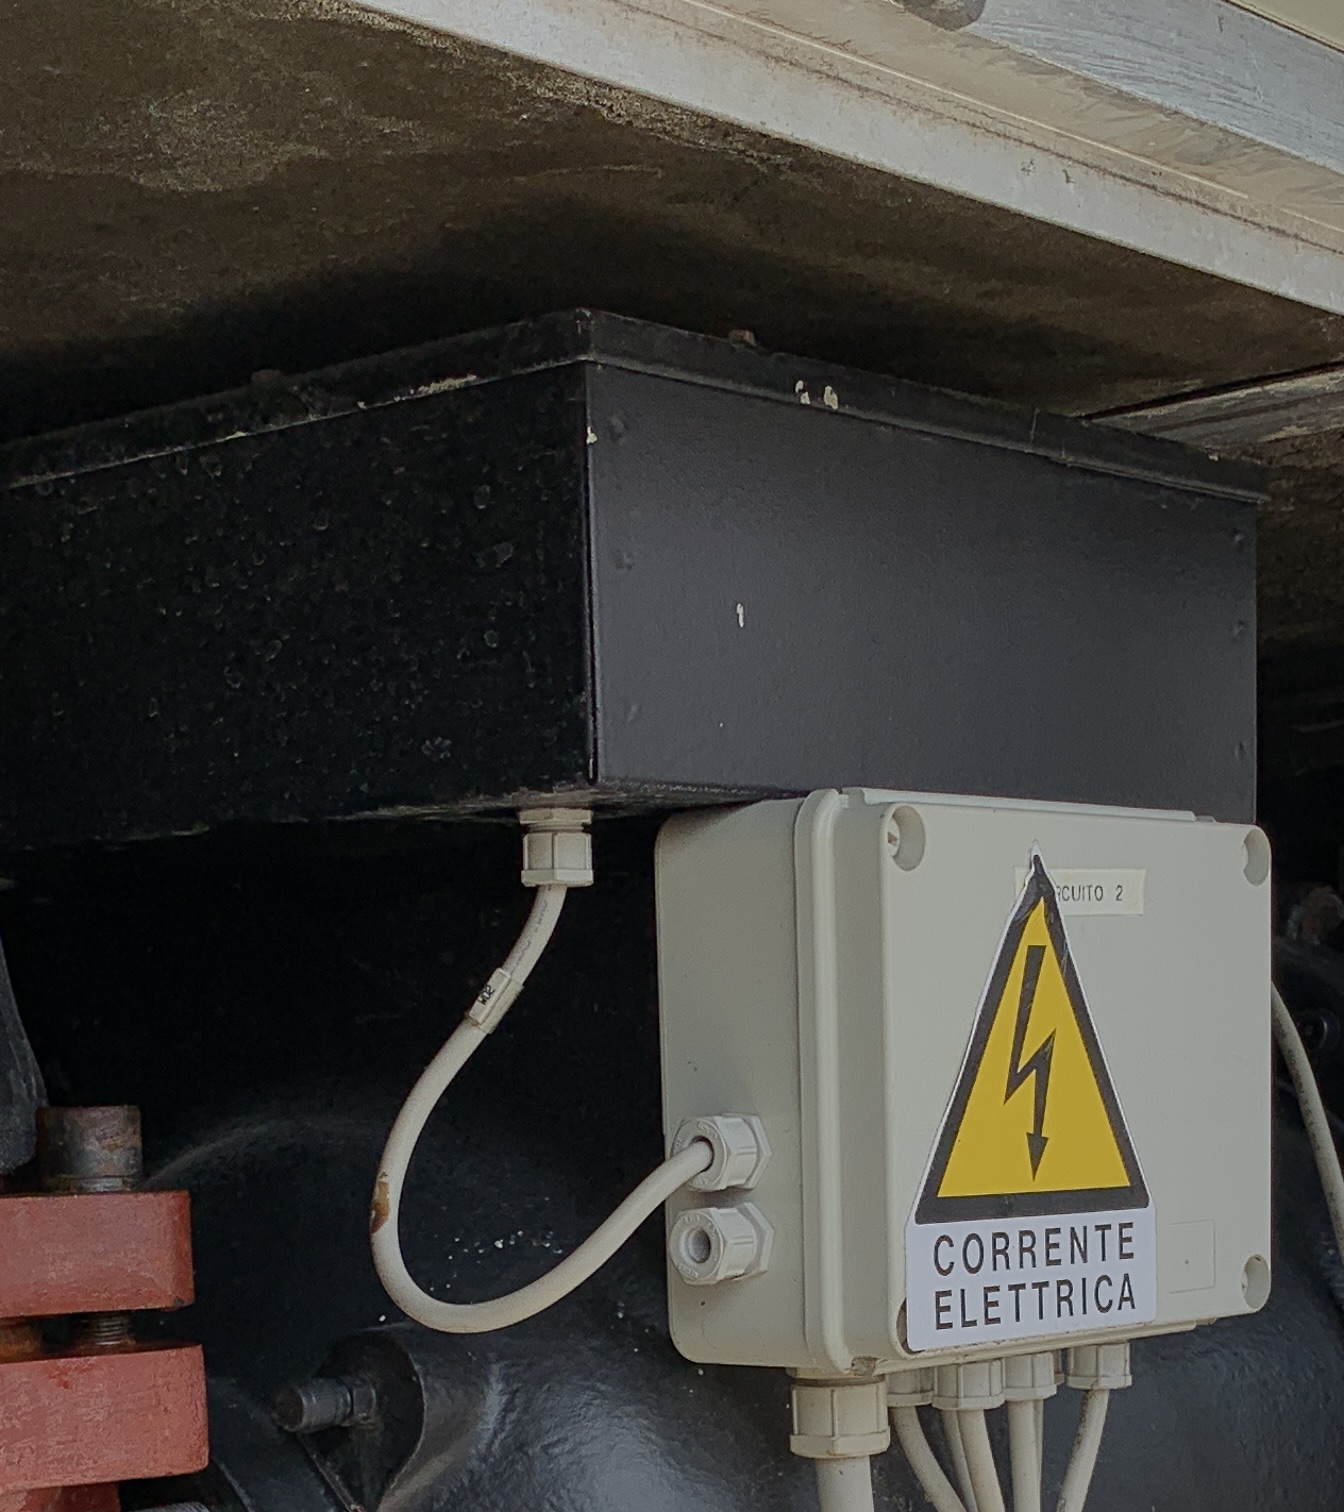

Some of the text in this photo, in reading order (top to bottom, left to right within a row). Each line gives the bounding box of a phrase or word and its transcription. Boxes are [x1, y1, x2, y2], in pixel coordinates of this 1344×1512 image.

[1056, 884, 1124, 902] RCUITO 2
[933, 1222, 1134, 1277] CORRENTE
[934, 1273, 1136, 1331] ELETTRICA
